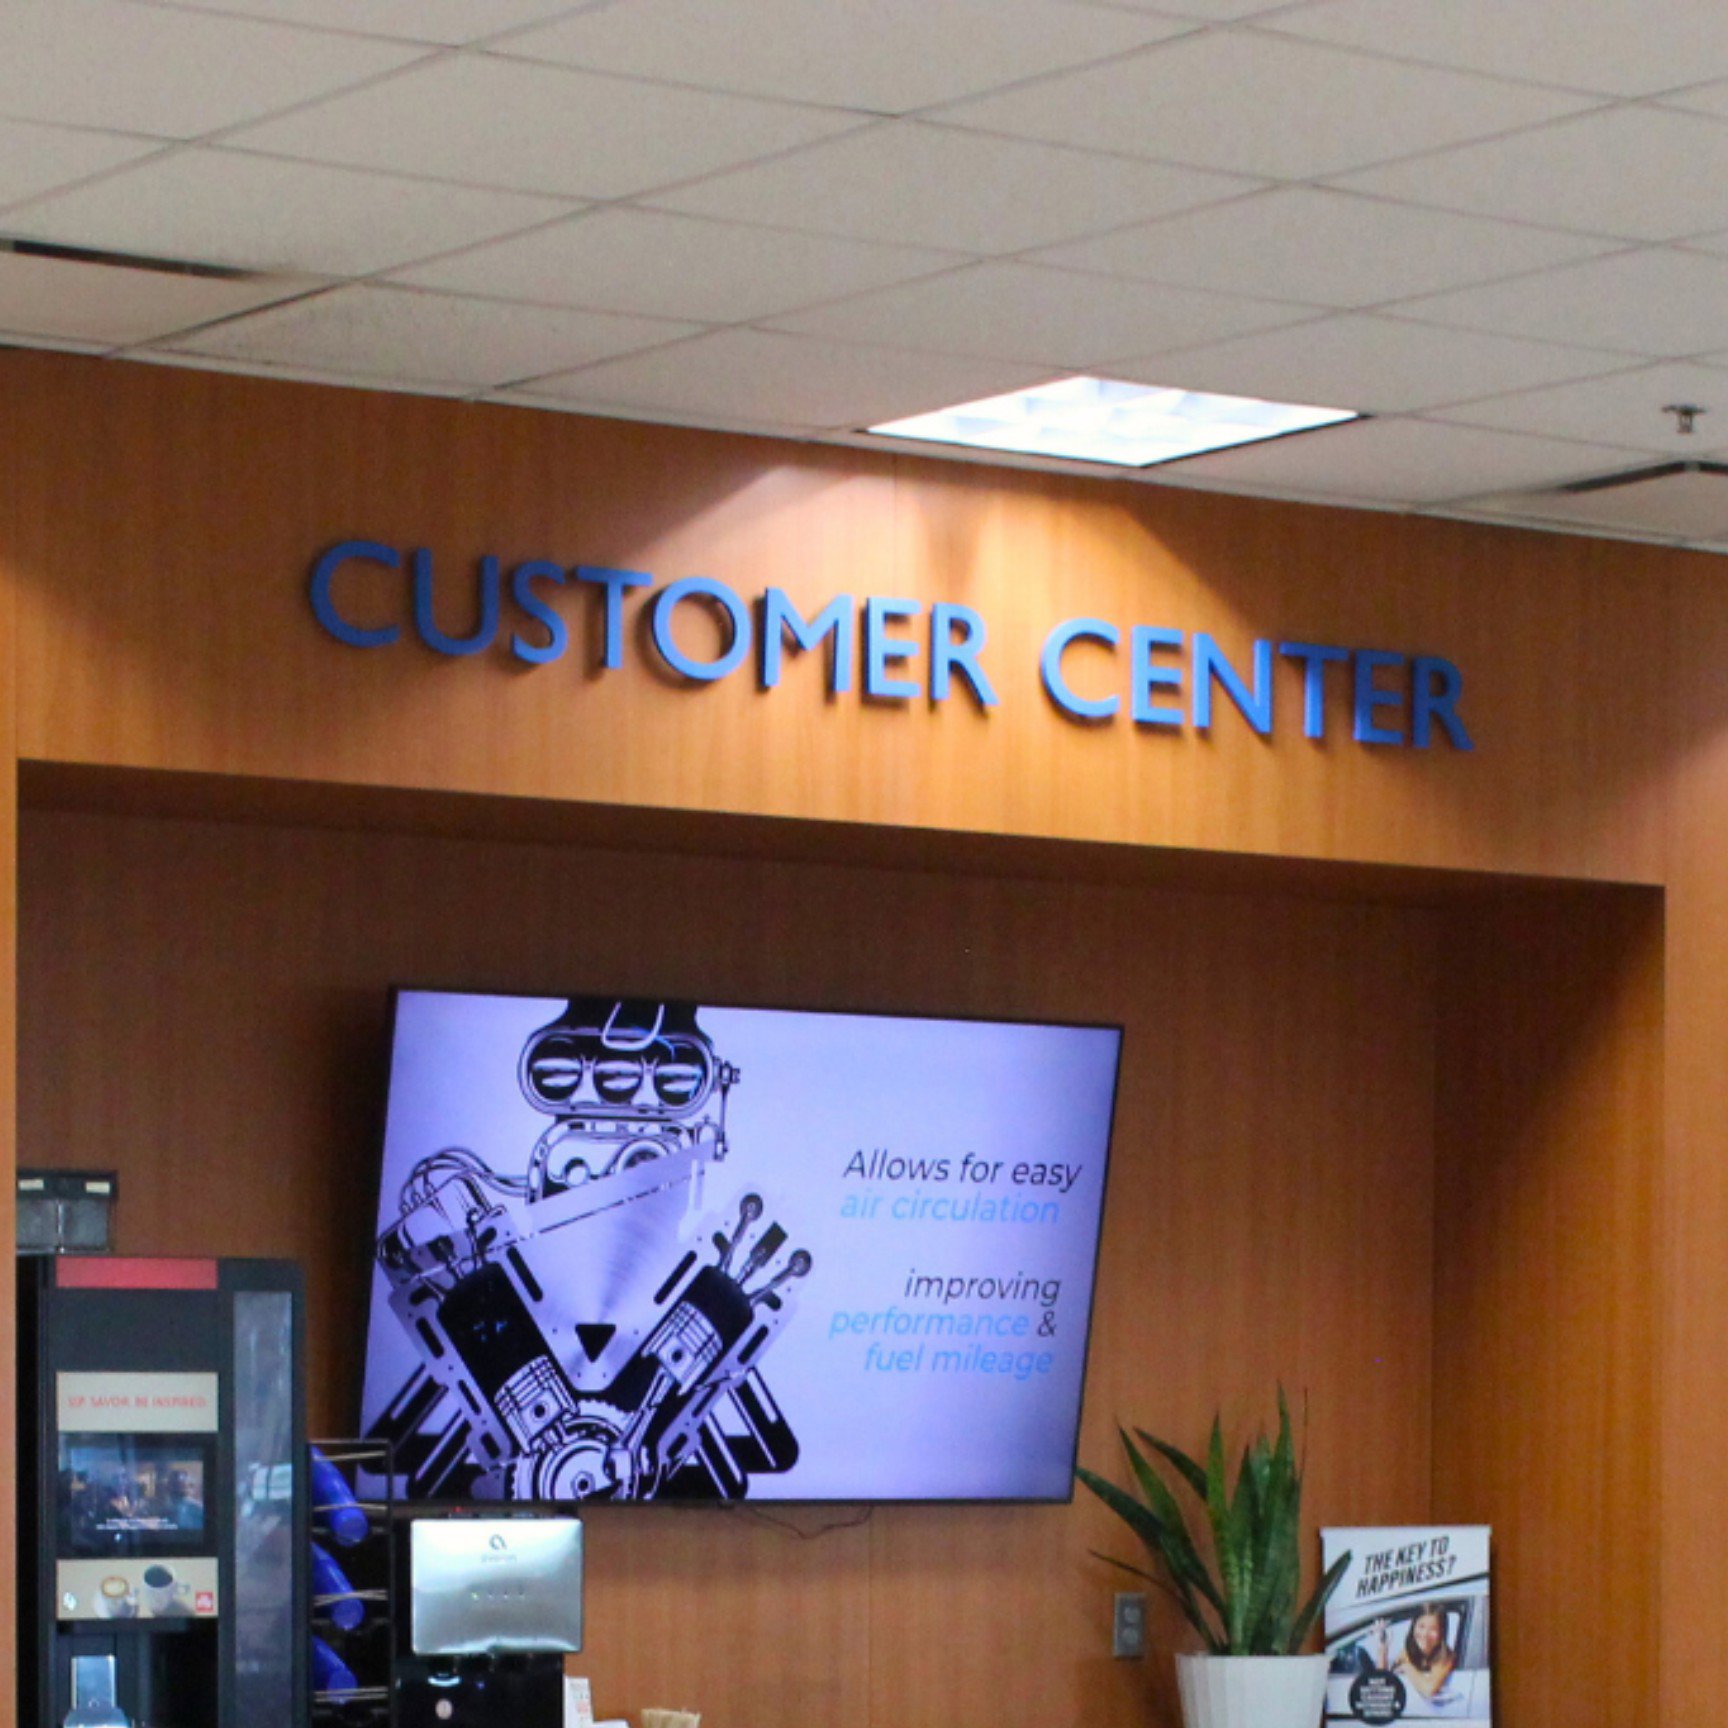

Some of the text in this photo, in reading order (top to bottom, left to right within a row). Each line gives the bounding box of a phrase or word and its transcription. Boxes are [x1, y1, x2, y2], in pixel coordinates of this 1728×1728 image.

[310, 539, 1475, 751] CUSTOMER CENTER
[843, 1149, 1083, 1194] Allows for easy
[840, 1188, 1060, 1224] air circulation
[904, 1267, 1061, 1307] improving
[828, 1306, 1057, 1340] performance &
[864, 1342, 1055, 1380] fuel mileage
[1365, 1535, 1450, 1574] THE KEY TO
[1355, 1554, 1457, 1598] HAPPINESS?
